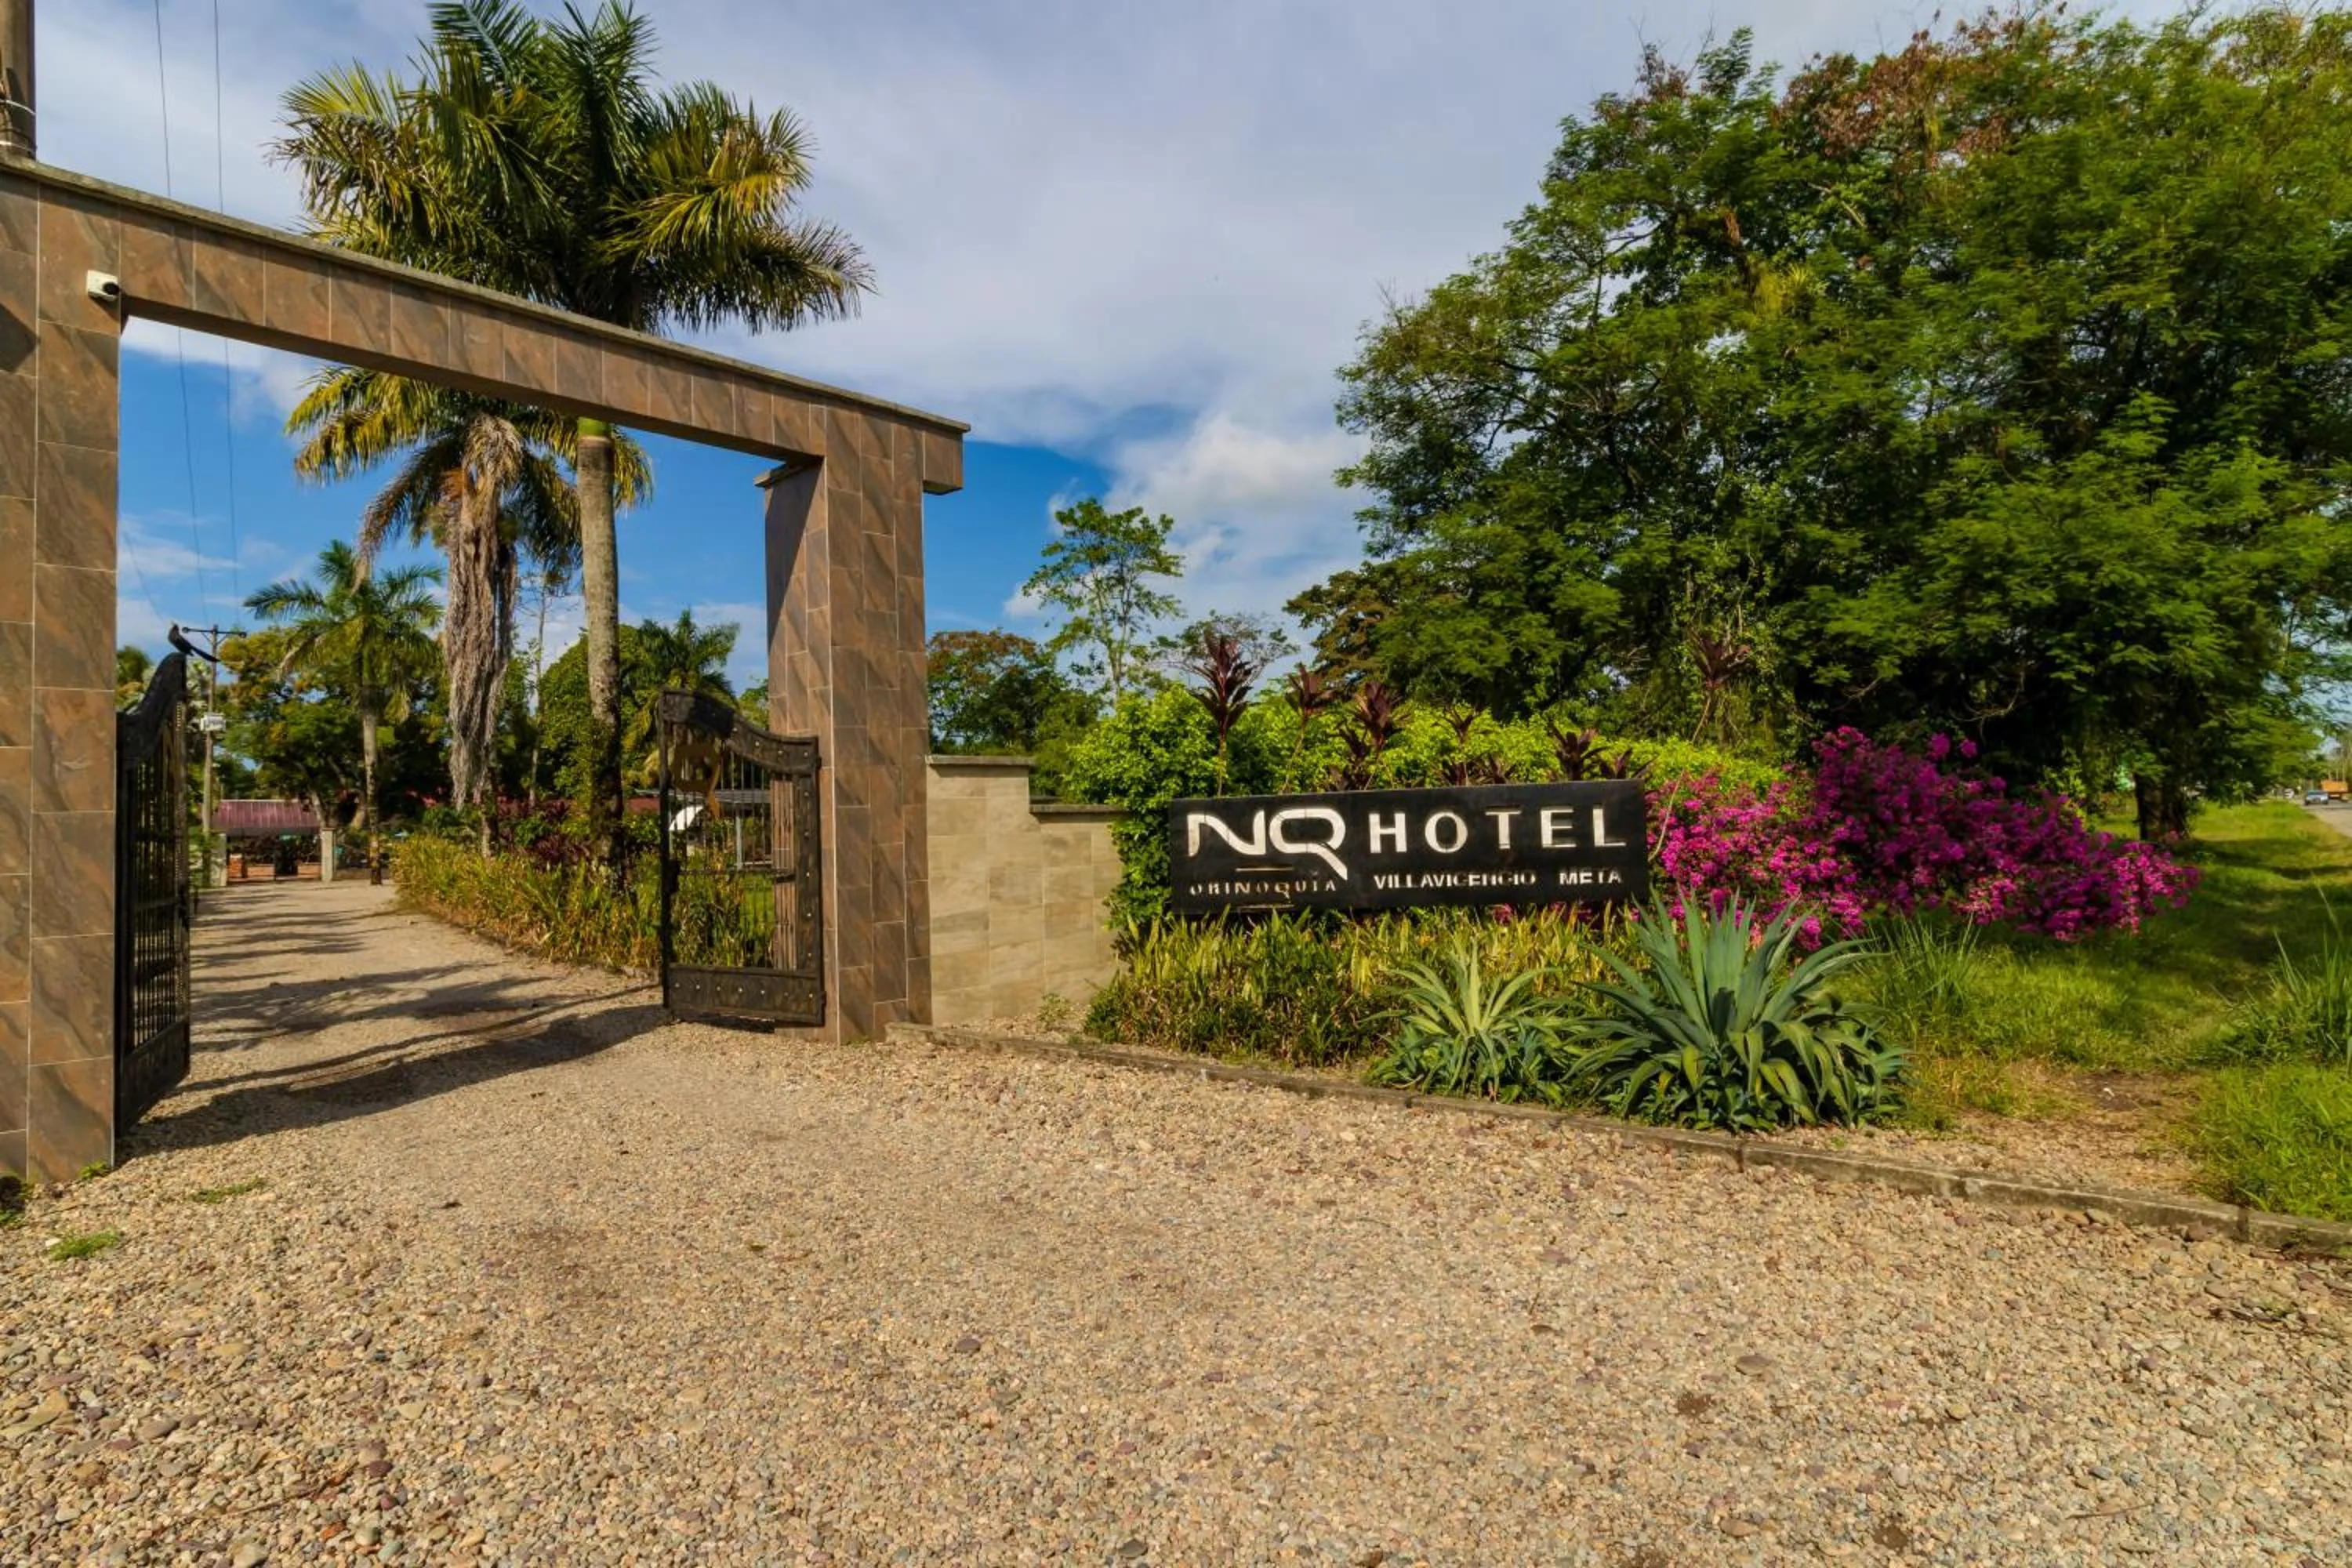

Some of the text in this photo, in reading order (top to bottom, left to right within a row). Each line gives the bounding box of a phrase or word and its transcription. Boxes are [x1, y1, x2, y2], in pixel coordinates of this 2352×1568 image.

[1186, 807, 1627, 880] NQ HOTEL
[1374, 865, 1622, 889] VILLAVICENCIO META
